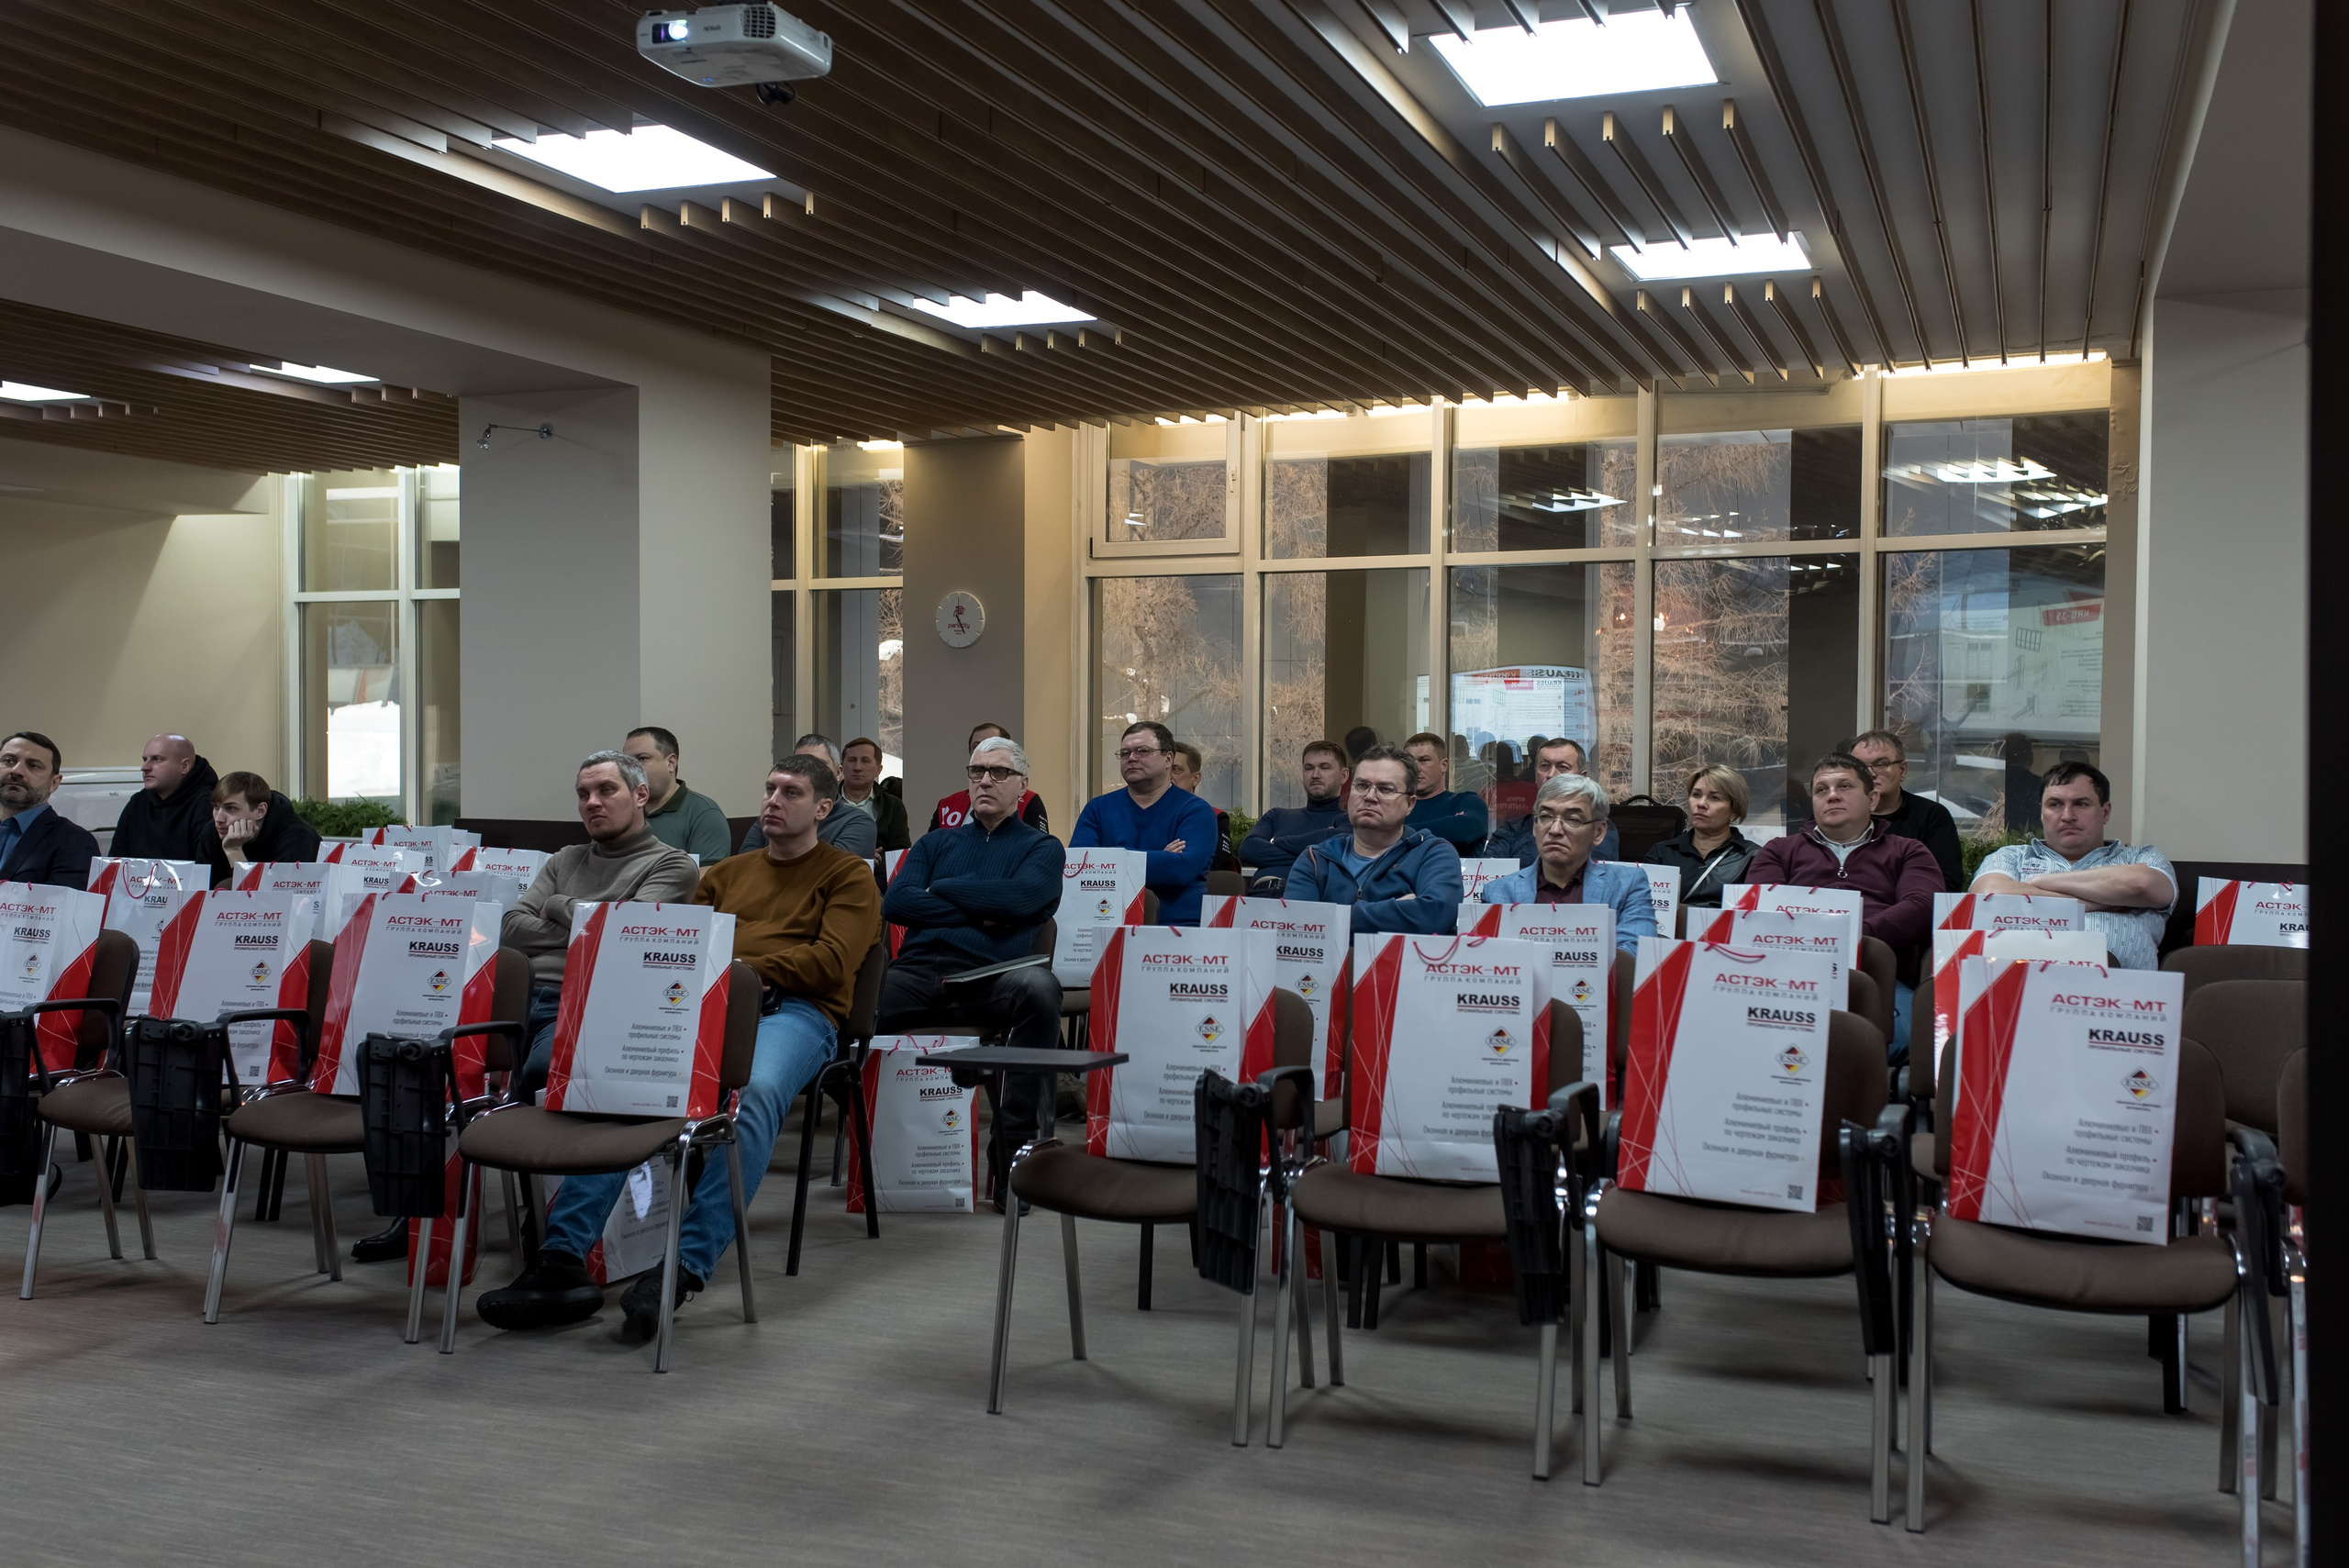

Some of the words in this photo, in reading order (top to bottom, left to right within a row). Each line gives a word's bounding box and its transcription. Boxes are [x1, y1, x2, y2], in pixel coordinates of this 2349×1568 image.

[0, 903, 56, 915] АСТЭК-МТ
[2255, 901, 2309, 910] АСТЭК-
[387, 916, 462, 927] АСТЭК-МТ
[1251, 919, 1326, 932] АСТЭК-МТ
[1993, 916, 2069, 927] АСТЭК-МТ
[14, 927, 50, 938] KRAUSS
[621, 926, 700, 937] АСТЭК-МТ
[1520, 927, 1598, 936] АСТЭК-МТ
[235, 935, 278, 944] KRAUSS
[1753, 935, 1838, 945] АСТЭК-МТ
[409, 941, 459, 952] KRAUSS
[1276, 946, 1324, 957] KRAUSS
[643, 952, 696, 963] KRAUSS
[1142, 954, 1229, 965] АСТЭК-МТ
[1553, 951, 1598, 961] RAUSS
[1177, 965, 1229, 973] КОМПАНИЙ
[1426, 963, 1520, 976] АСТЭК-МТ
[429, 977, 448, 985] ESSE
[1465, 977, 1521, 985] КОМПАНИЙ
[1715, 973, 1819, 991] АСТЭК-МТ
[1170, 984, 1228, 995] KRAUSS
[1713, 985, 1754, 995] ГРУППА
[1758, 991, 1819, 1001] КОМПАНИЙ
[1457, 994, 1520, 1006] KRAUSS
[2052, 994, 2167, 1012] АСТЭК-МТ
[1748, 1006, 1816, 1024] KRAUSS
[2099, 1012, 2166, 1023] КОМПАНИЙ
[1199, 1025, 1220, 1033] ESSE
[1489, 1037, 1512, 1046] ESSE
[2088, 1029, 2165, 1047] KRAUSS
[896, 1066, 952, 1075] АСТЭК-М
[919, 1086, 963, 1096] KRAUSS
